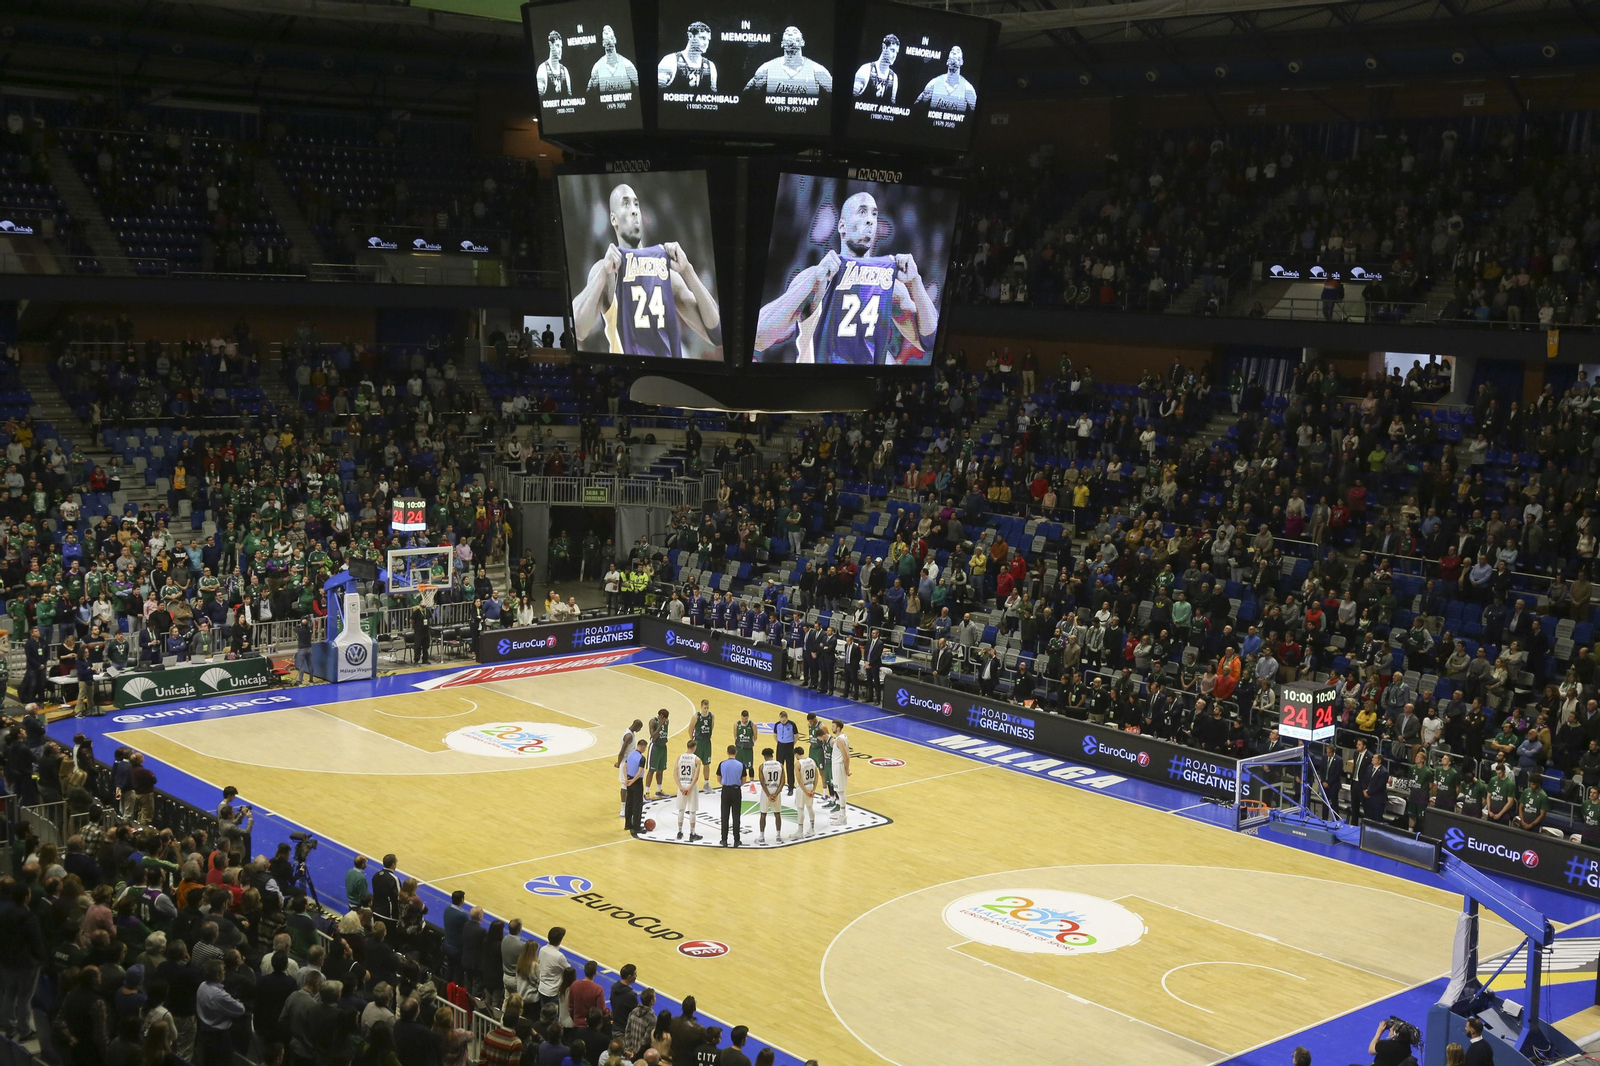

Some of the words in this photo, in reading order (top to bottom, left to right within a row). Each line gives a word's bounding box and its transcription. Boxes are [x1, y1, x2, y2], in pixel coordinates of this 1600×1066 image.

[577, 24, 584, 34] IN
[741, 20, 751, 30] IN
[567, 35, 597, 46] MEMORIAM
[721, 32, 771, 44] MEMORIAM
[921, 36, 929, 46] IN
[905, 46, 942, 60] MEMORIAM
[543, 100, 560, 108] ROBERT
[560, 98, 586, 107] ARCHIBALD
[600, 94, 613, 102] KOBE
[613, 93, 632, 102] BRYANT
[663, 92, 694, 103] ROBERT
[695, 94, 740, 104] ARCHIBALD
[765, 96, 786, 105] KOBE
[787, 96, 820, 106] BRYANT
[854, 102, 878, 112] ROBERT
[878, 104, 911, 116] ARCHIBALD
[928, 110, 942, 120] KOBE
[942, 113, 966, 122] BRYANT
[614, 160, 650, 172] MONDO
[858, 168, 902, 184] MONDO
[623, 252, 669, 282] LAKERS
[835, 260, 895, 290] LAKERS
[631, 285, 666, 330] 24
[837, 294, 881, 337] 24
[393, 510, 404, 523] 24
[407, 510, 424, 524] 24
[512, 638, 546, 650] EuroCup
[584, 630, 634, 646] GREATNESS
[676, 636, 701, 650] EuroCup
[730, 653, 772, 672] GREATNESS
[230, 673, 267, 688] Unicaja
[155, 682, 196, 698] Unicaja
[1284, 689, 1313, 704] 10:00
[1316, 690, 1336, 704] 10:00
[112, 696, 292, 724] @unicajaCB
[910, 695, 942, 712] EuroCup
[1283, 705, 1308, 728] 24
[1315, 705, 1333, 728] 24
[980, 717, 1035, 740] GREATNESS
[1098, 743, 1137, 763] EuroCup
[926, 734, 1128, 789] MALAGA
[681, 765, 691, 776] 23
[768, 771, 778, 782] 10
[805, 768, 814, 780] 30
[1467, 837, 1521, 862] EuroCup
[570, 892, 684, 940] EuroCup
[968, 906, 1028, 930] MALAGA
[981, 896, 1098, 946] 2020
[959, 908, 1004, 926] EUROPEAN
[1002, 924, 1034, 938] CAPITAL
[1046, 940, 1076, 952] SPORT
[692, 948, 725, 956] DAYS
[698, 1052, 716, 1062] CITY
